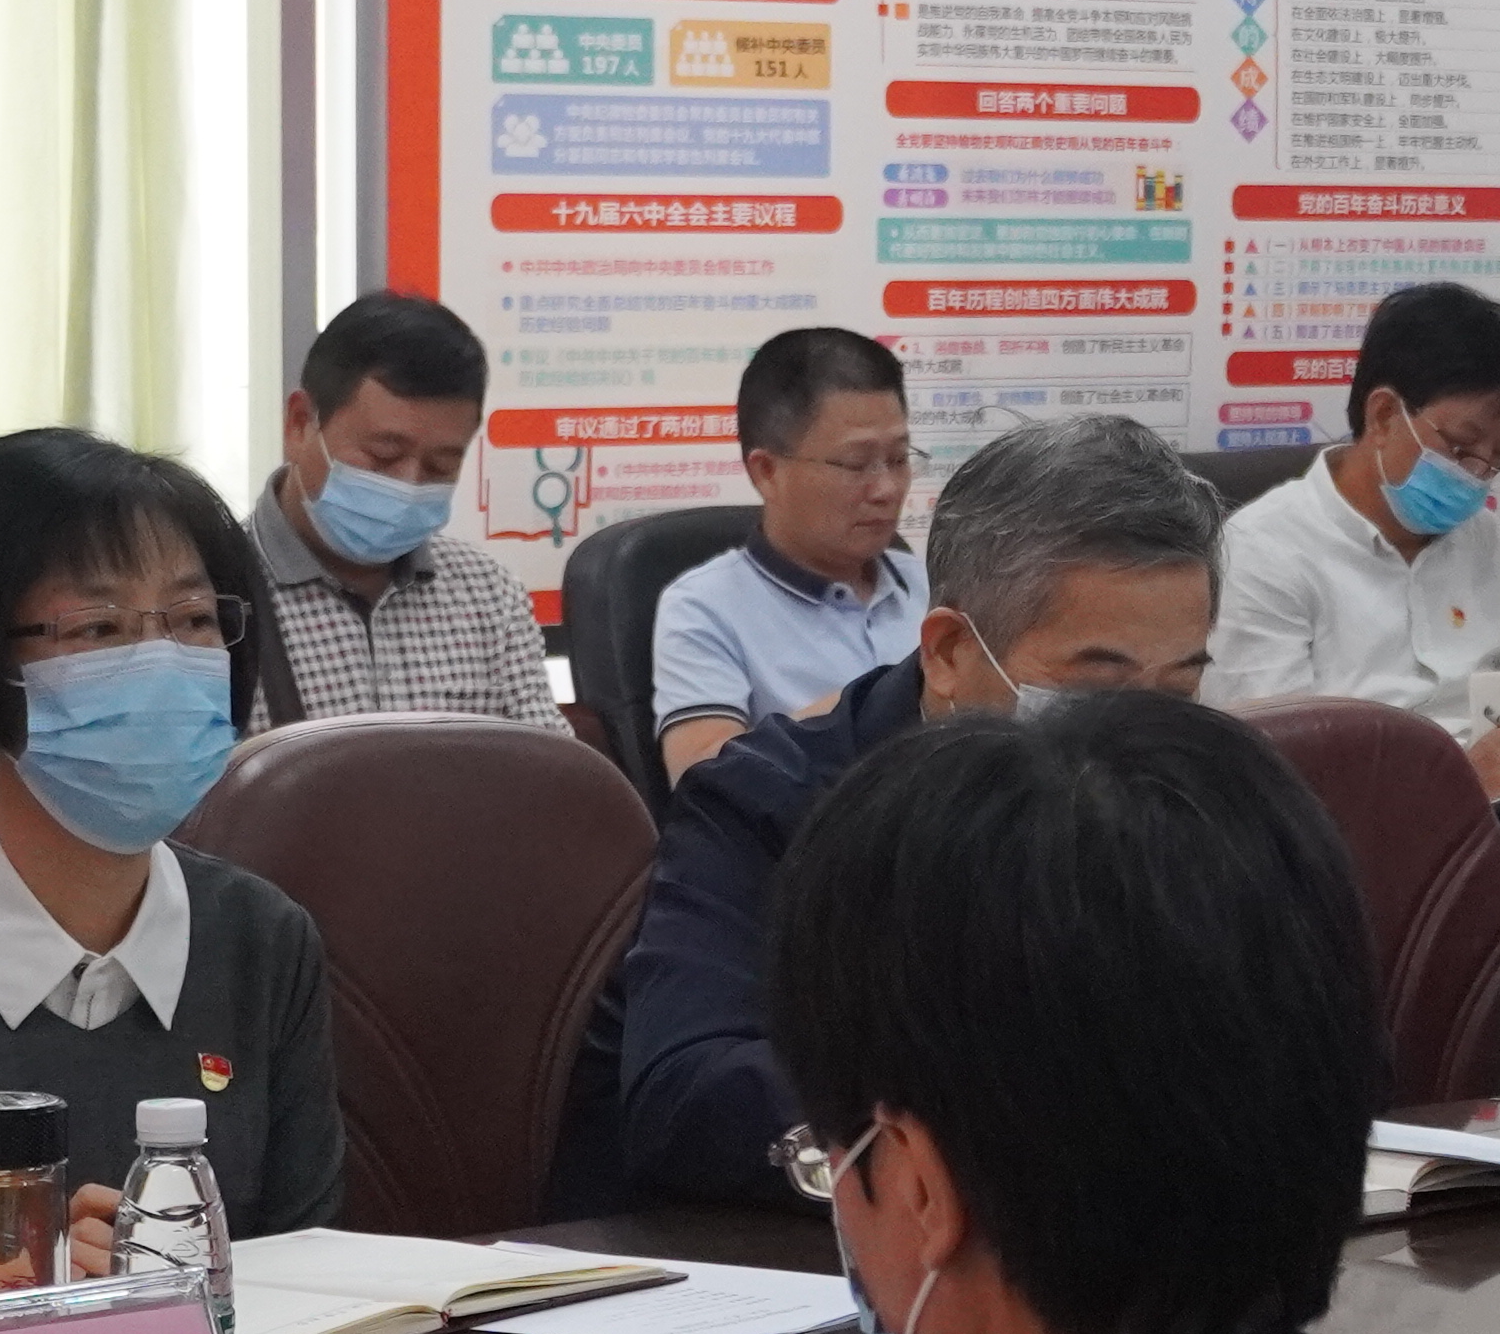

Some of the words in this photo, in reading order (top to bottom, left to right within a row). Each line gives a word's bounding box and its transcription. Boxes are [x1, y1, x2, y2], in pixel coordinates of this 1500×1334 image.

[578, 33, 642, 53] 中央委员
[736, 36, 826, 56] 候补中央委员
[977, 91, 1127, 115] 回答两个重要问题
[552, 201, 797, 227] 十九届六中全会主要议程
[1298, 192, 1466, 216] 党的百年奋斗历史意义
[928, 288, 1169, 312] 百年历程创造四方面伟大成就
